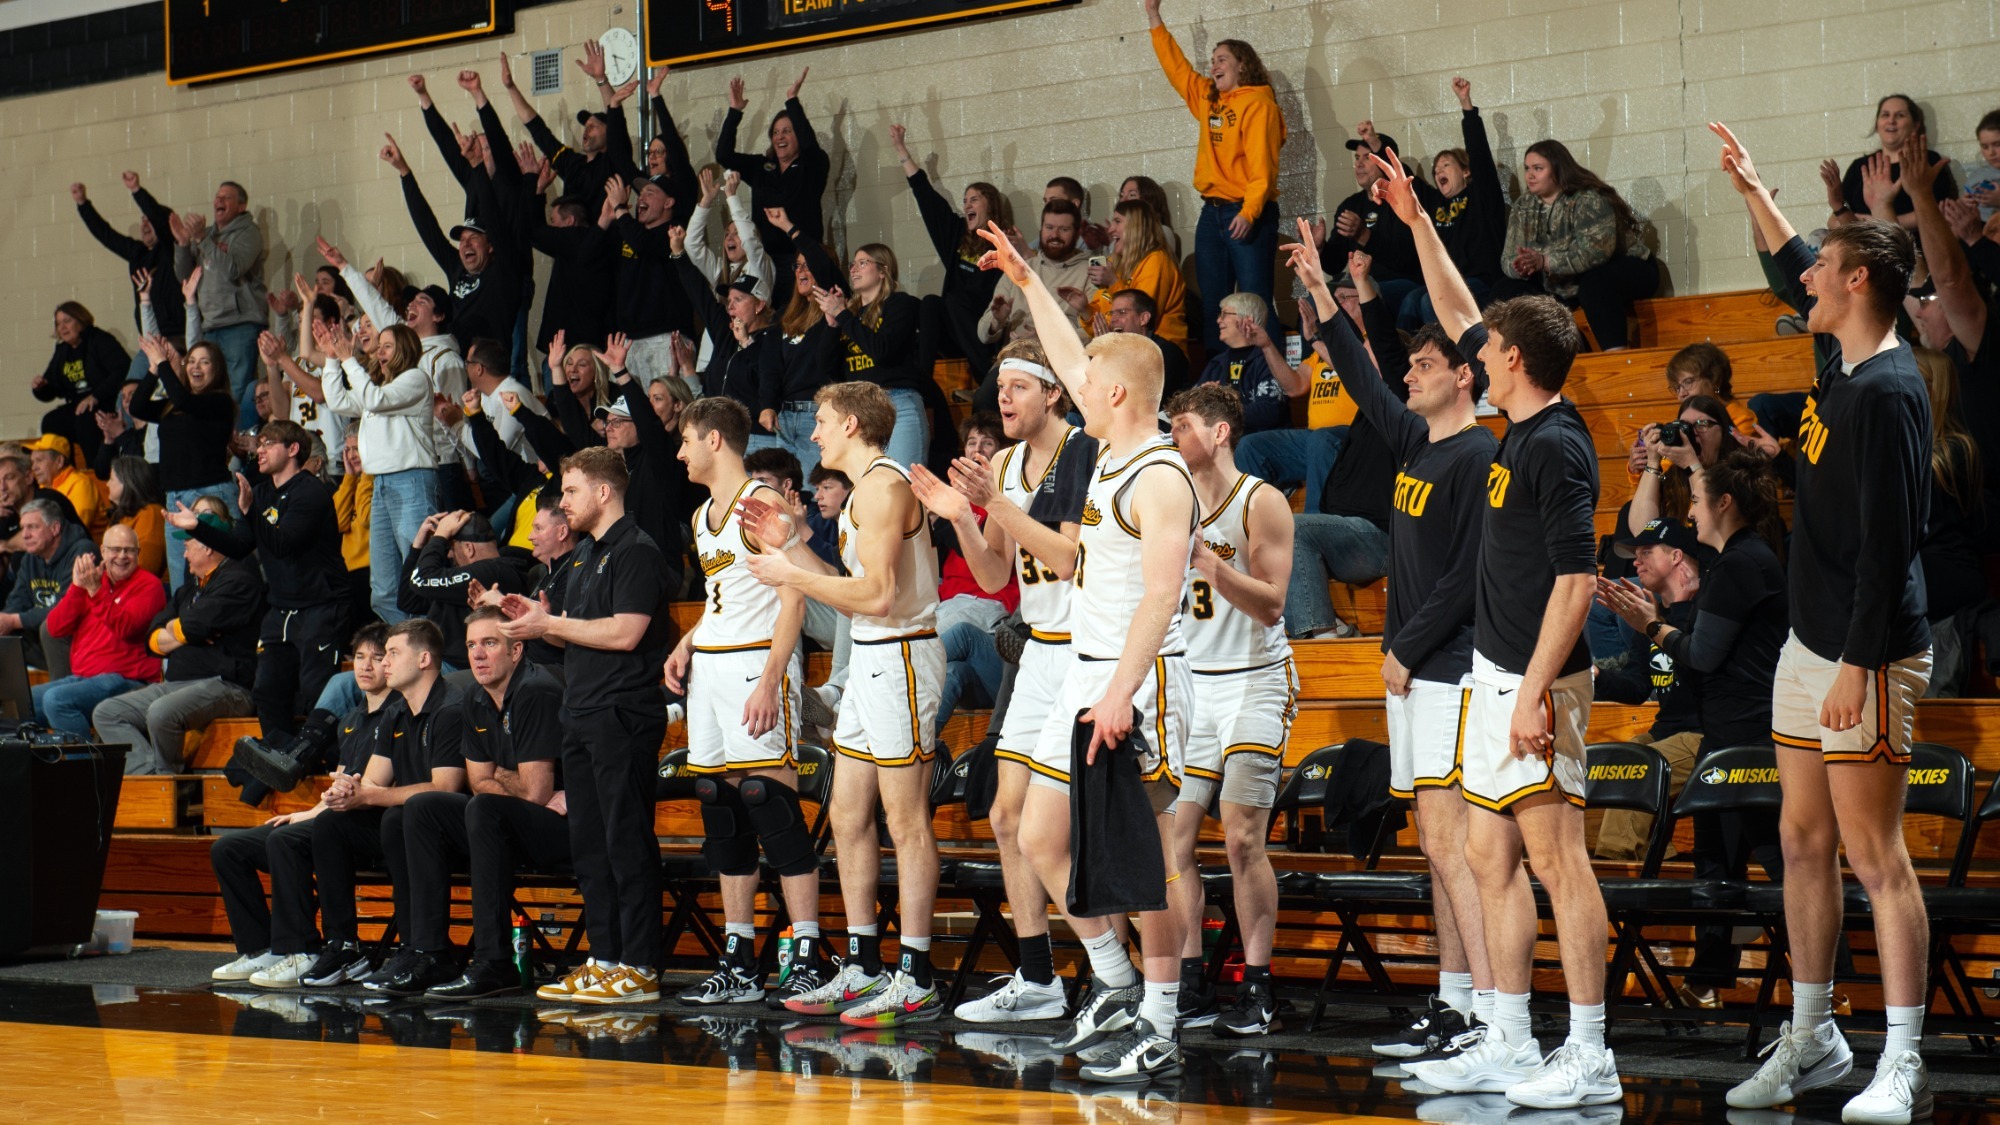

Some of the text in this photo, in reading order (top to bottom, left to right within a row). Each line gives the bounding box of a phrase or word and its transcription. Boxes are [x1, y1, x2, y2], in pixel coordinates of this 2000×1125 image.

[1313, 381, 1341, 399] TECH
[700, 548, 735, 577] Huskies
[713, 581, 722, 615] 1
[1588, 764, 1649, 780] HUSKIES
